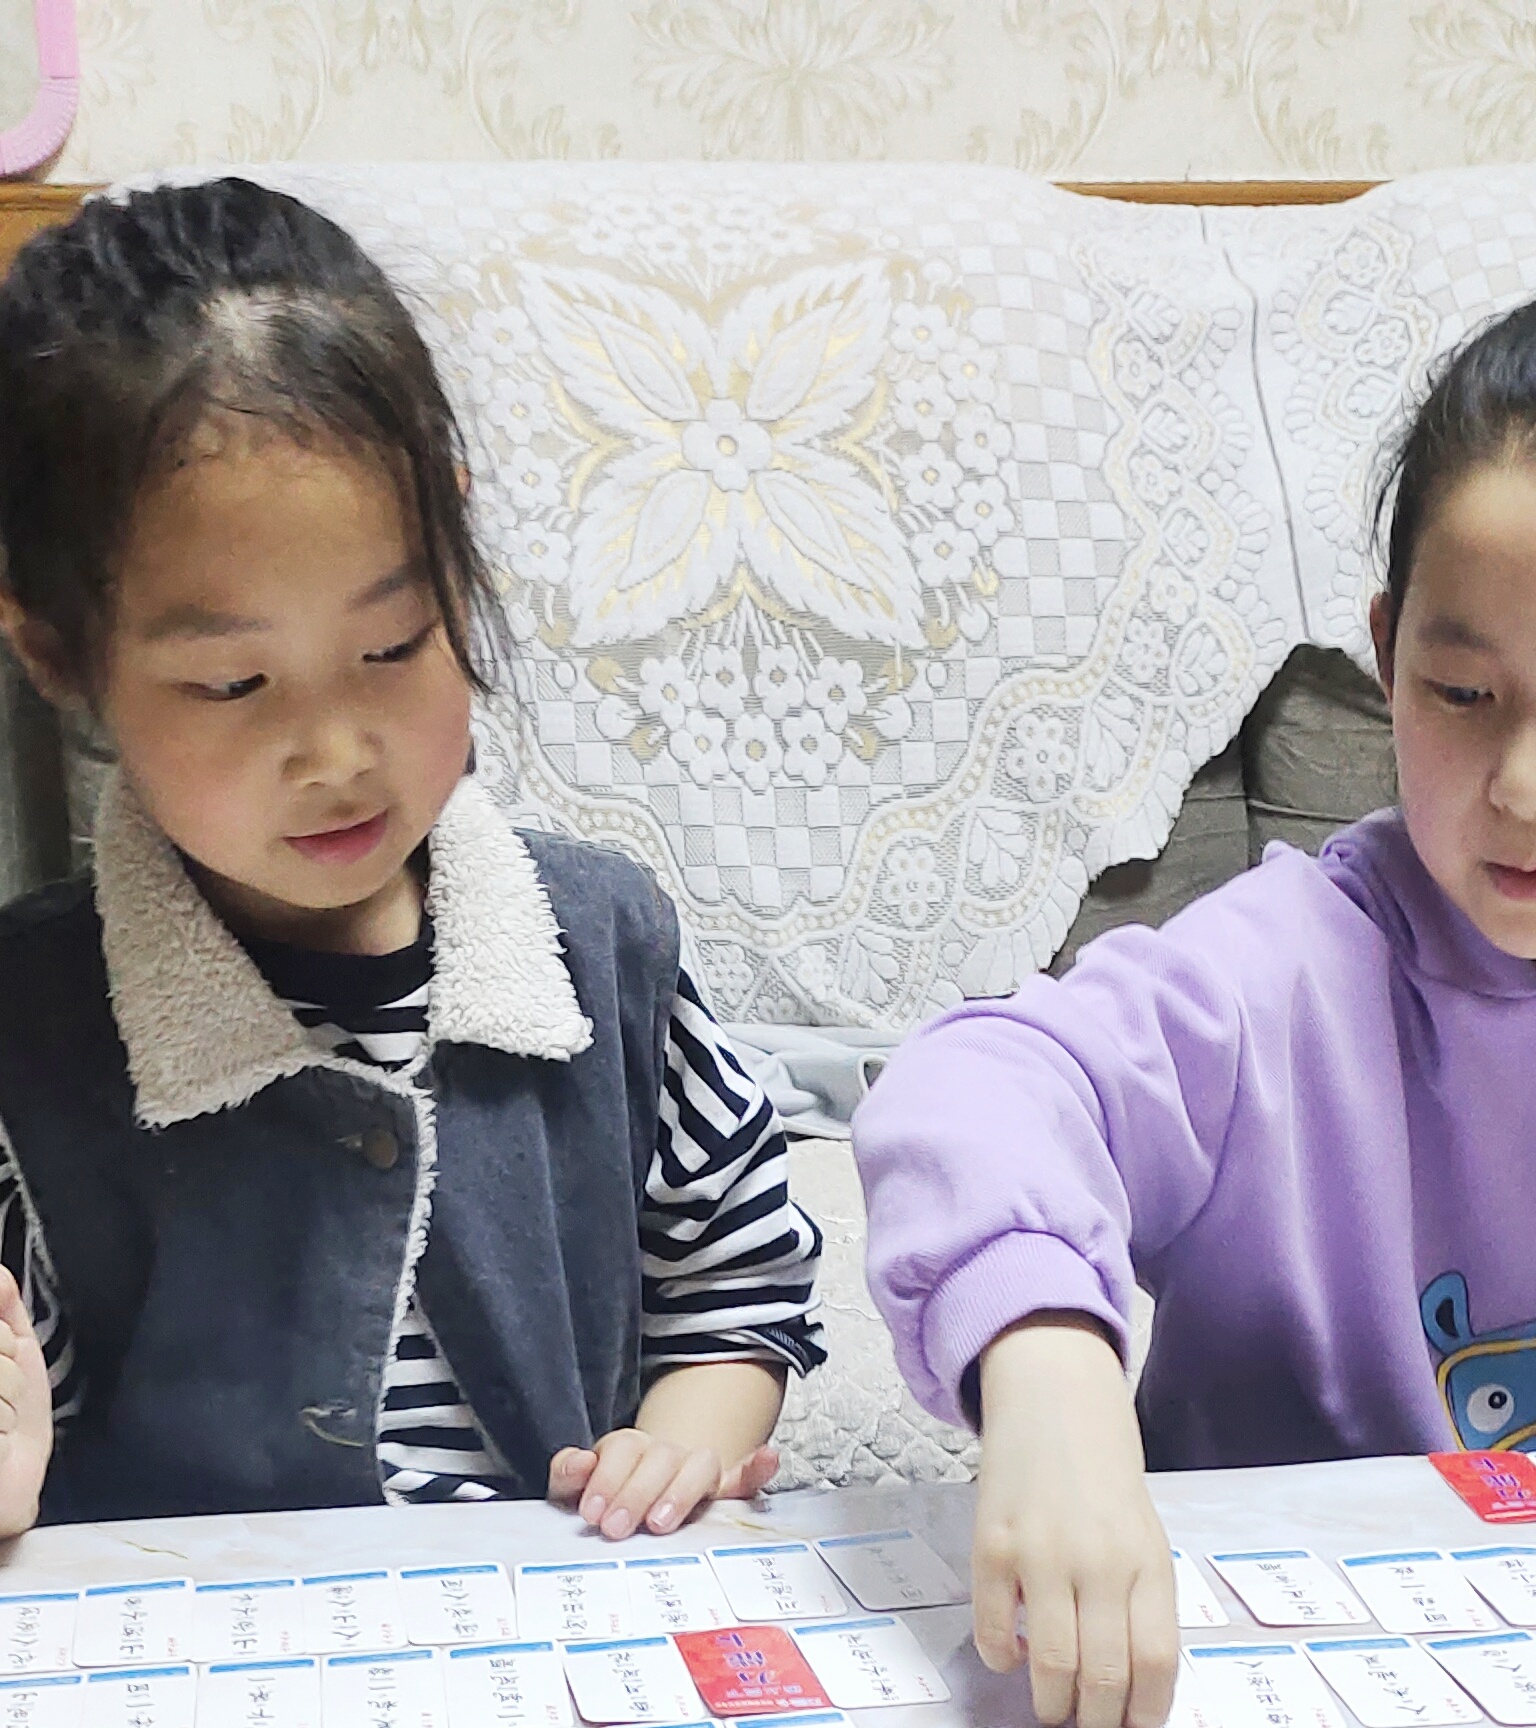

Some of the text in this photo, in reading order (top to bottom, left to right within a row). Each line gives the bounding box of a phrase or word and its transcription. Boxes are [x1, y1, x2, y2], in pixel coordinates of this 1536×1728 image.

[709, 1630, 778, 1686] 万能卡
[489, 1658, 524, 1718] 一帆风顺
